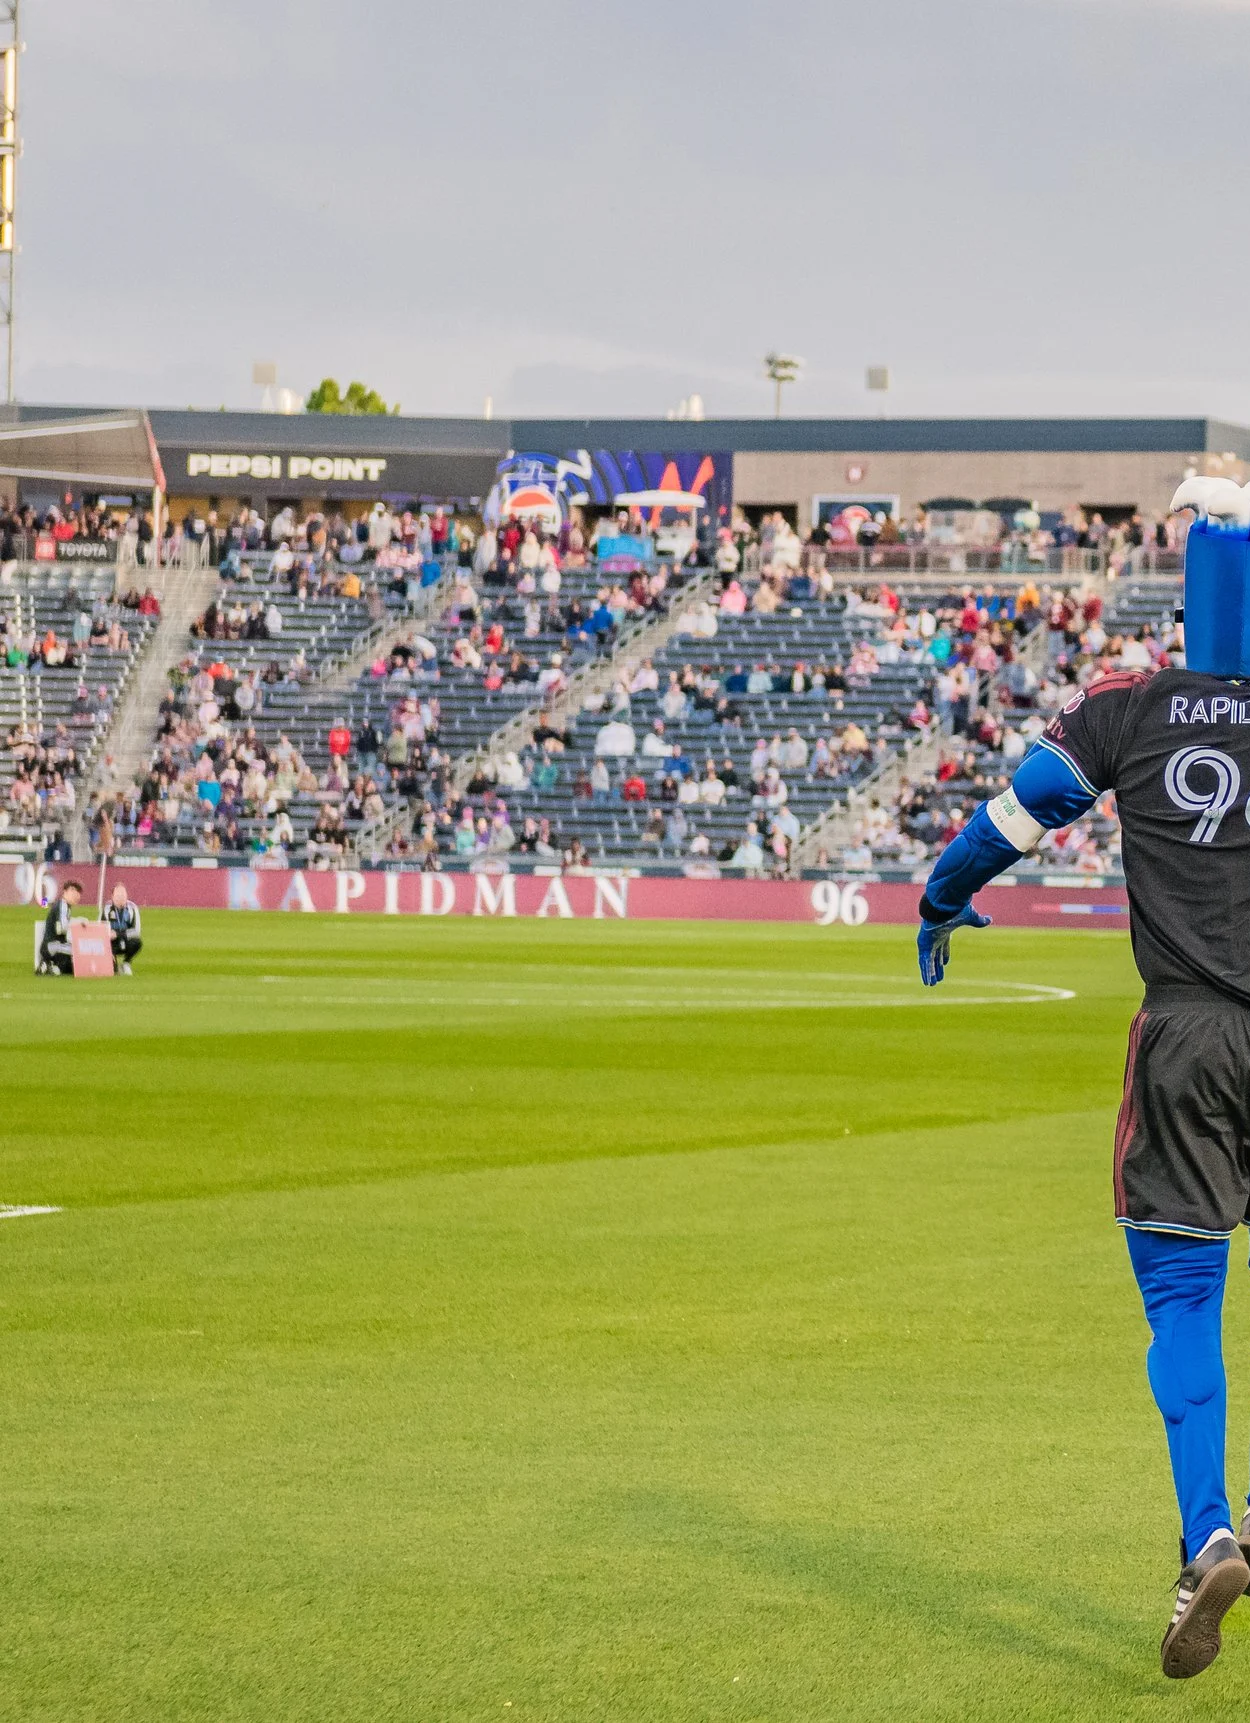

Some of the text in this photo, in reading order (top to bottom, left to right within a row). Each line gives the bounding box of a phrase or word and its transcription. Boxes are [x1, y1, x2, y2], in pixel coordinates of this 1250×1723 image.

[187, 453, 387, 481] PEPSI POINT
[58, 542, 107, 557] TOYOTA
[227, 869, 630, 919] RAPIDMAN
[811, 880, 869, 926] 96
